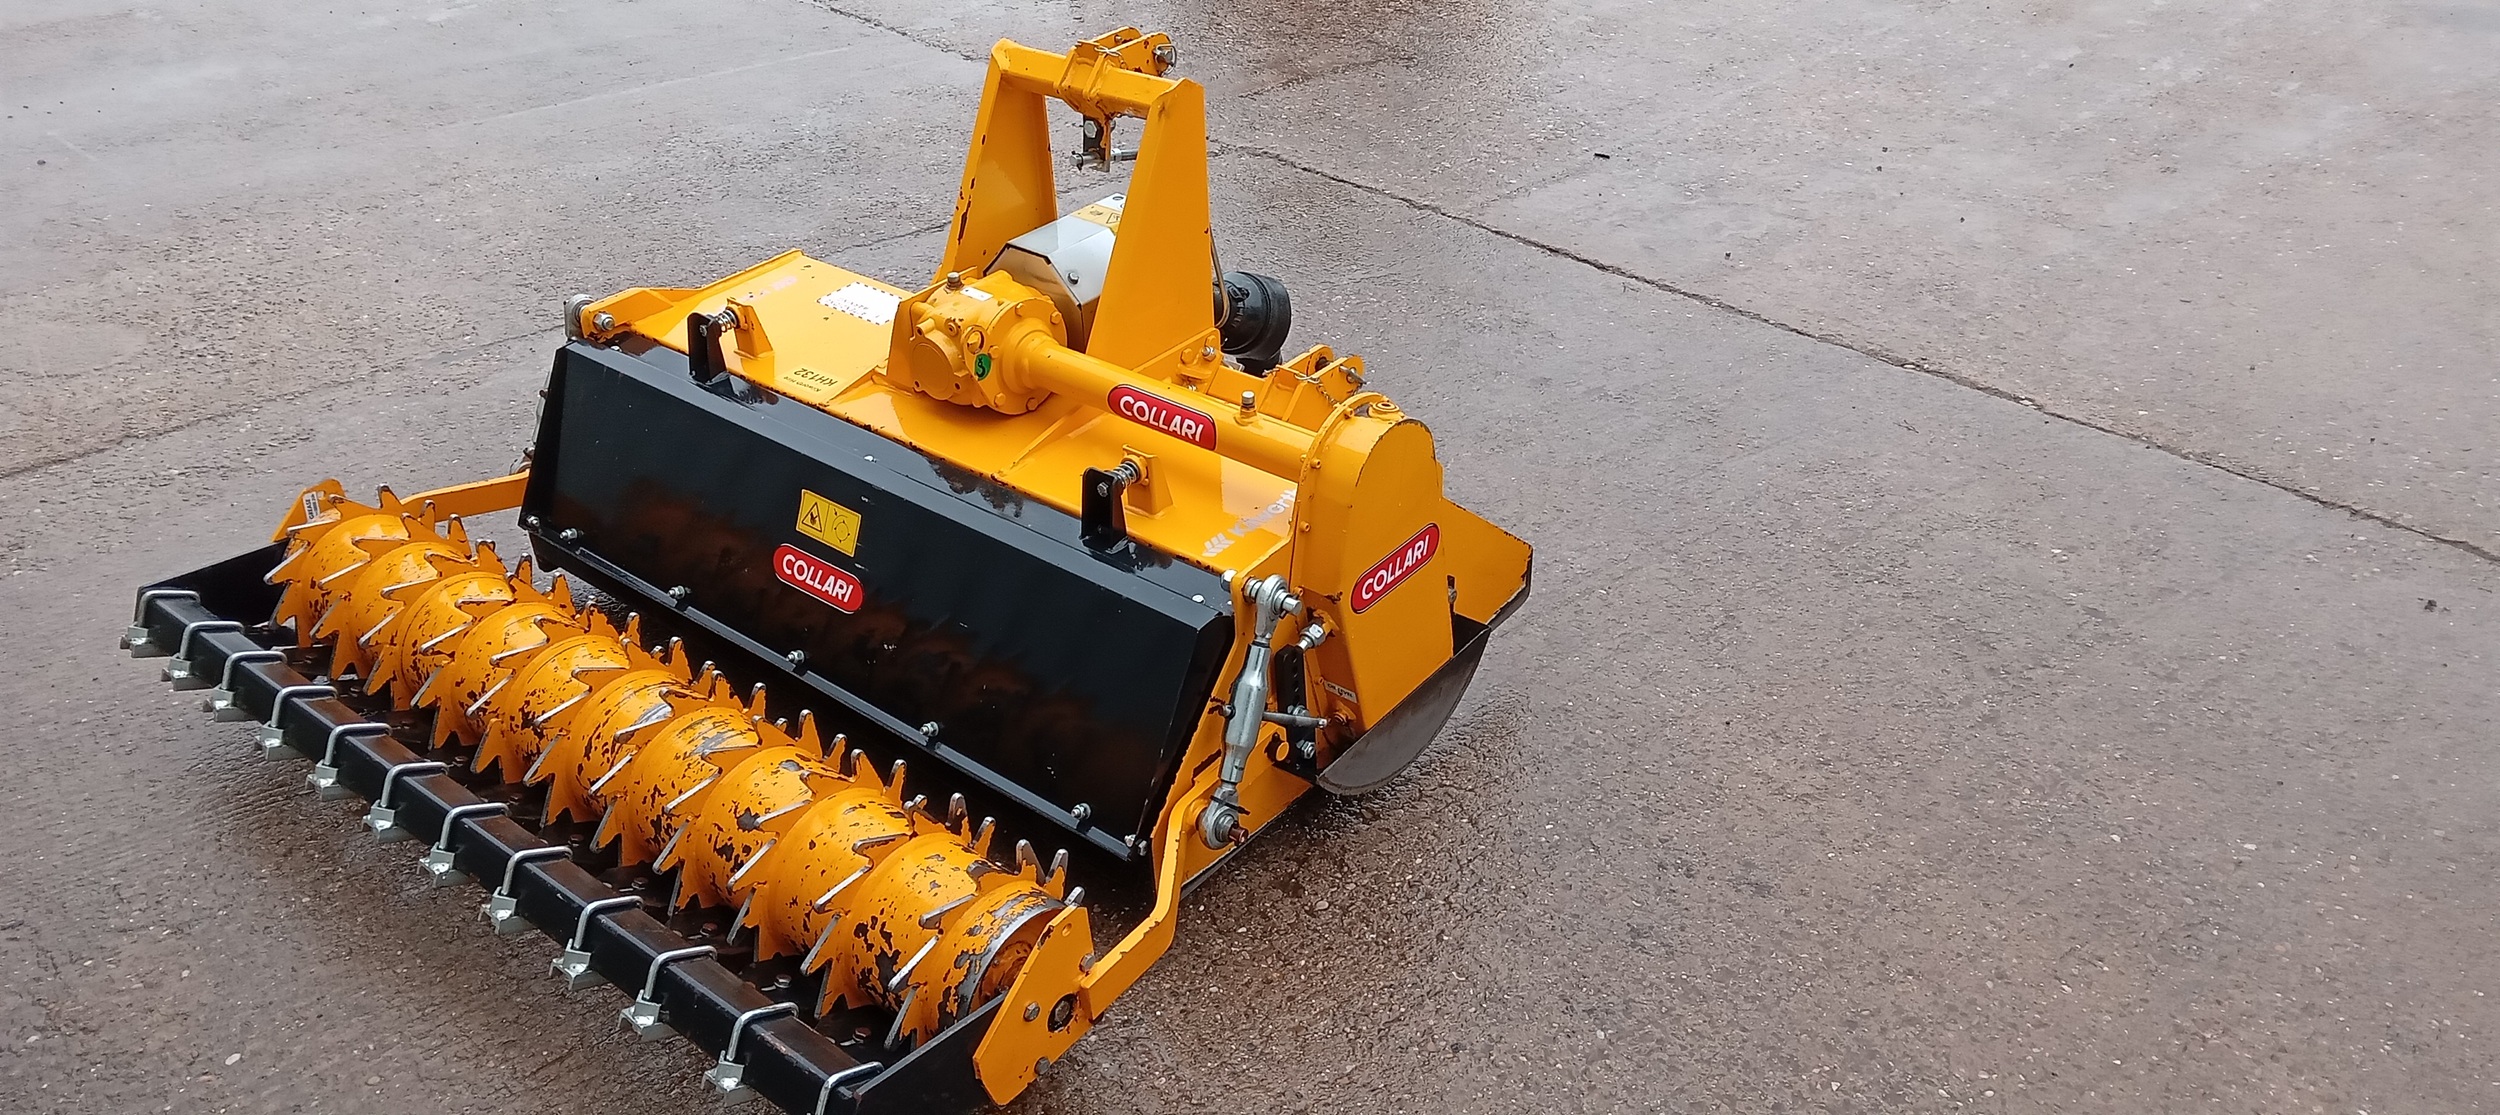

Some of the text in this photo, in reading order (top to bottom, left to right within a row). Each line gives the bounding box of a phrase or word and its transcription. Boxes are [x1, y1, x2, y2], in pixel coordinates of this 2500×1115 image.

[794, 368, 838, 386] KH132
[1120, 396, 1204, 442] COLLARI
[782, 554, 853, 602] COLLARI
[1361, 535, 1429, 600] COLLARI
